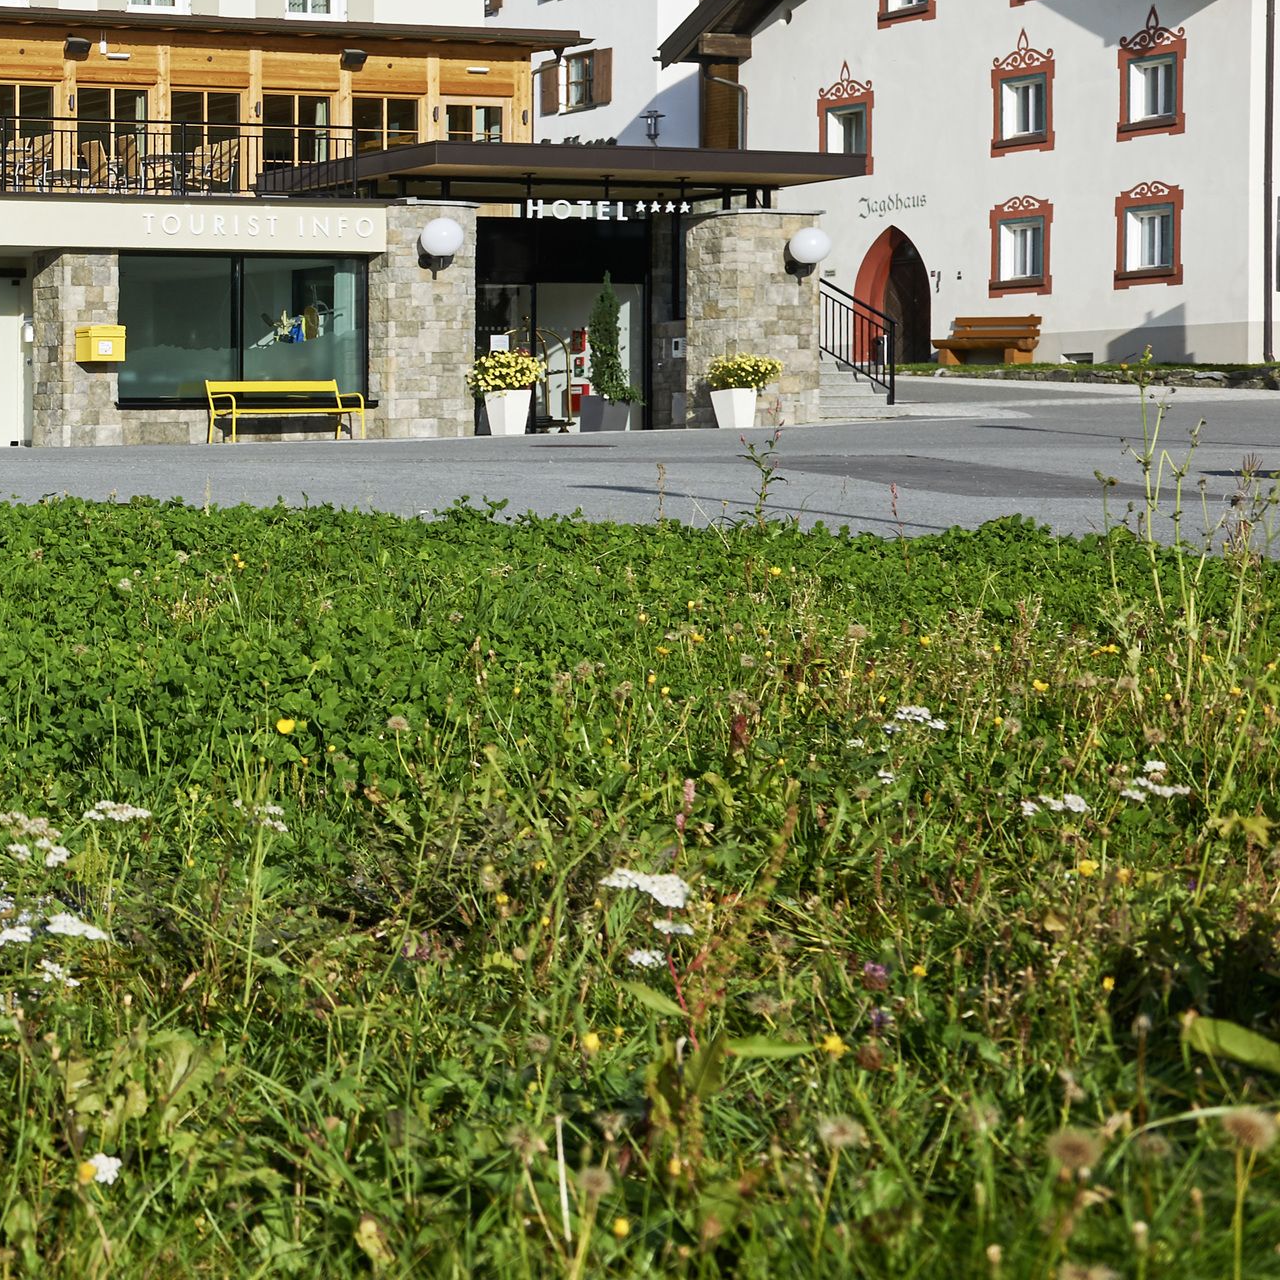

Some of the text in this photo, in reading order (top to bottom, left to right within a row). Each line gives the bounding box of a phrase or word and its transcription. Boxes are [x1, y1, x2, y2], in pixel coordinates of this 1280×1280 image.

[526, 199, 628, 221] HOTEL
[858, 193, 928, 219] Jagdhaus
[142, 213, 374, 238] TOURIST INFO
